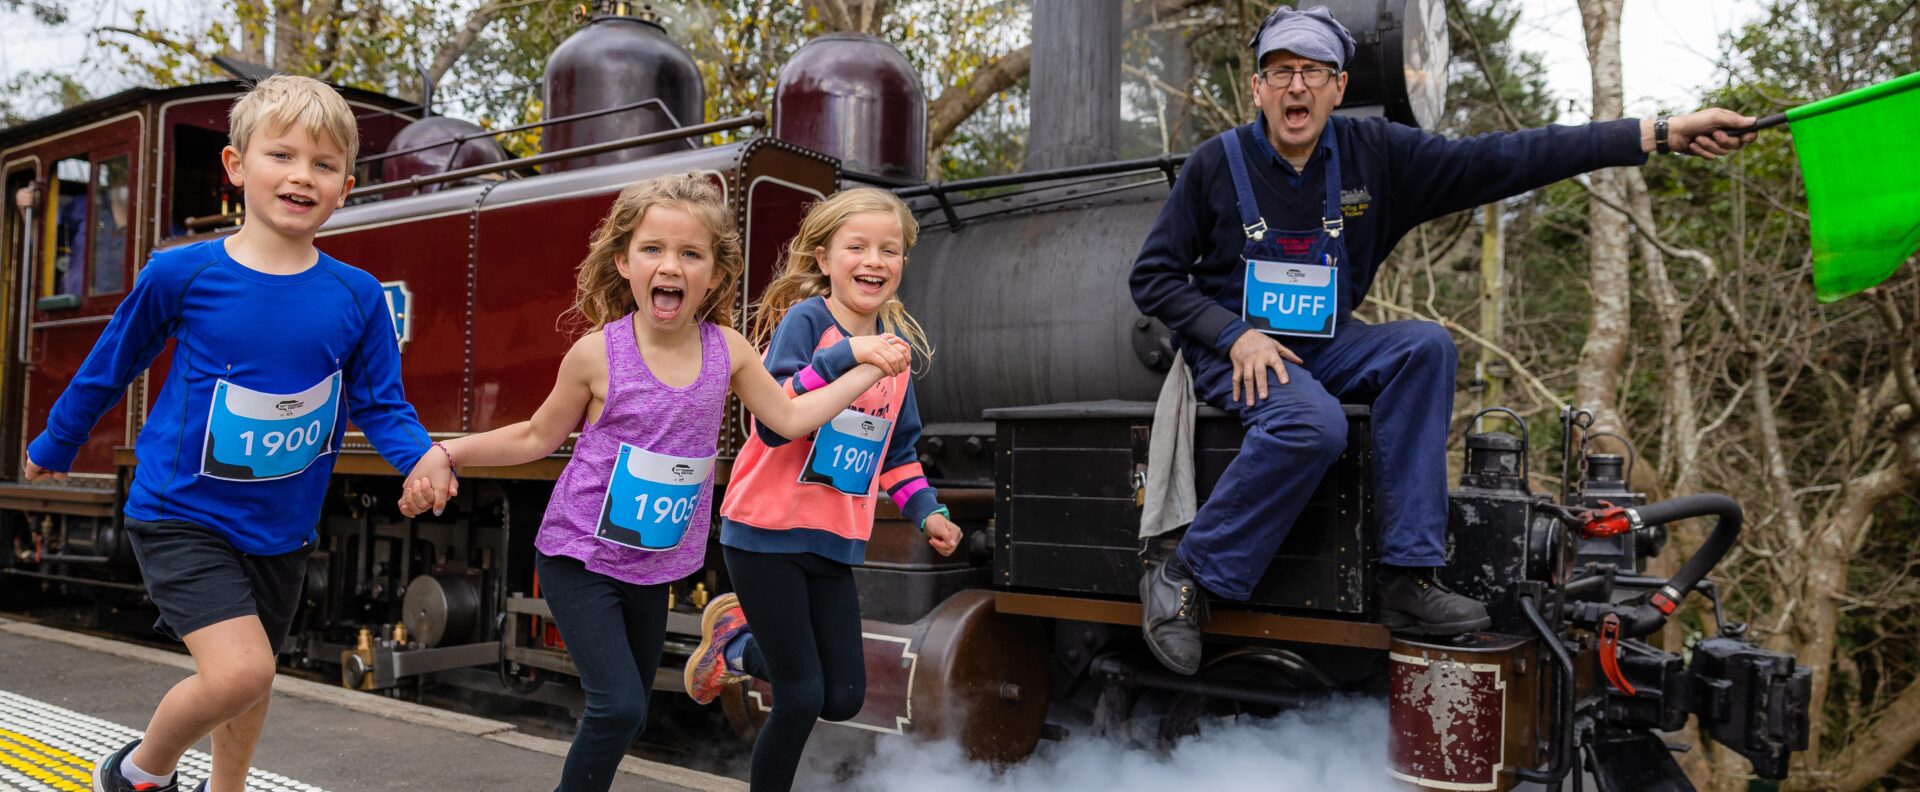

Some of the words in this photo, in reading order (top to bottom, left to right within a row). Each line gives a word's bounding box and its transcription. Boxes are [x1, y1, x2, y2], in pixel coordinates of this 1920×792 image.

[1261, 291, 1326, 316] PUFF
[239, 419, 321, 457] 1900
[832, 444, 875, 474] 1901
[634, 493, 698, 524] 1905
